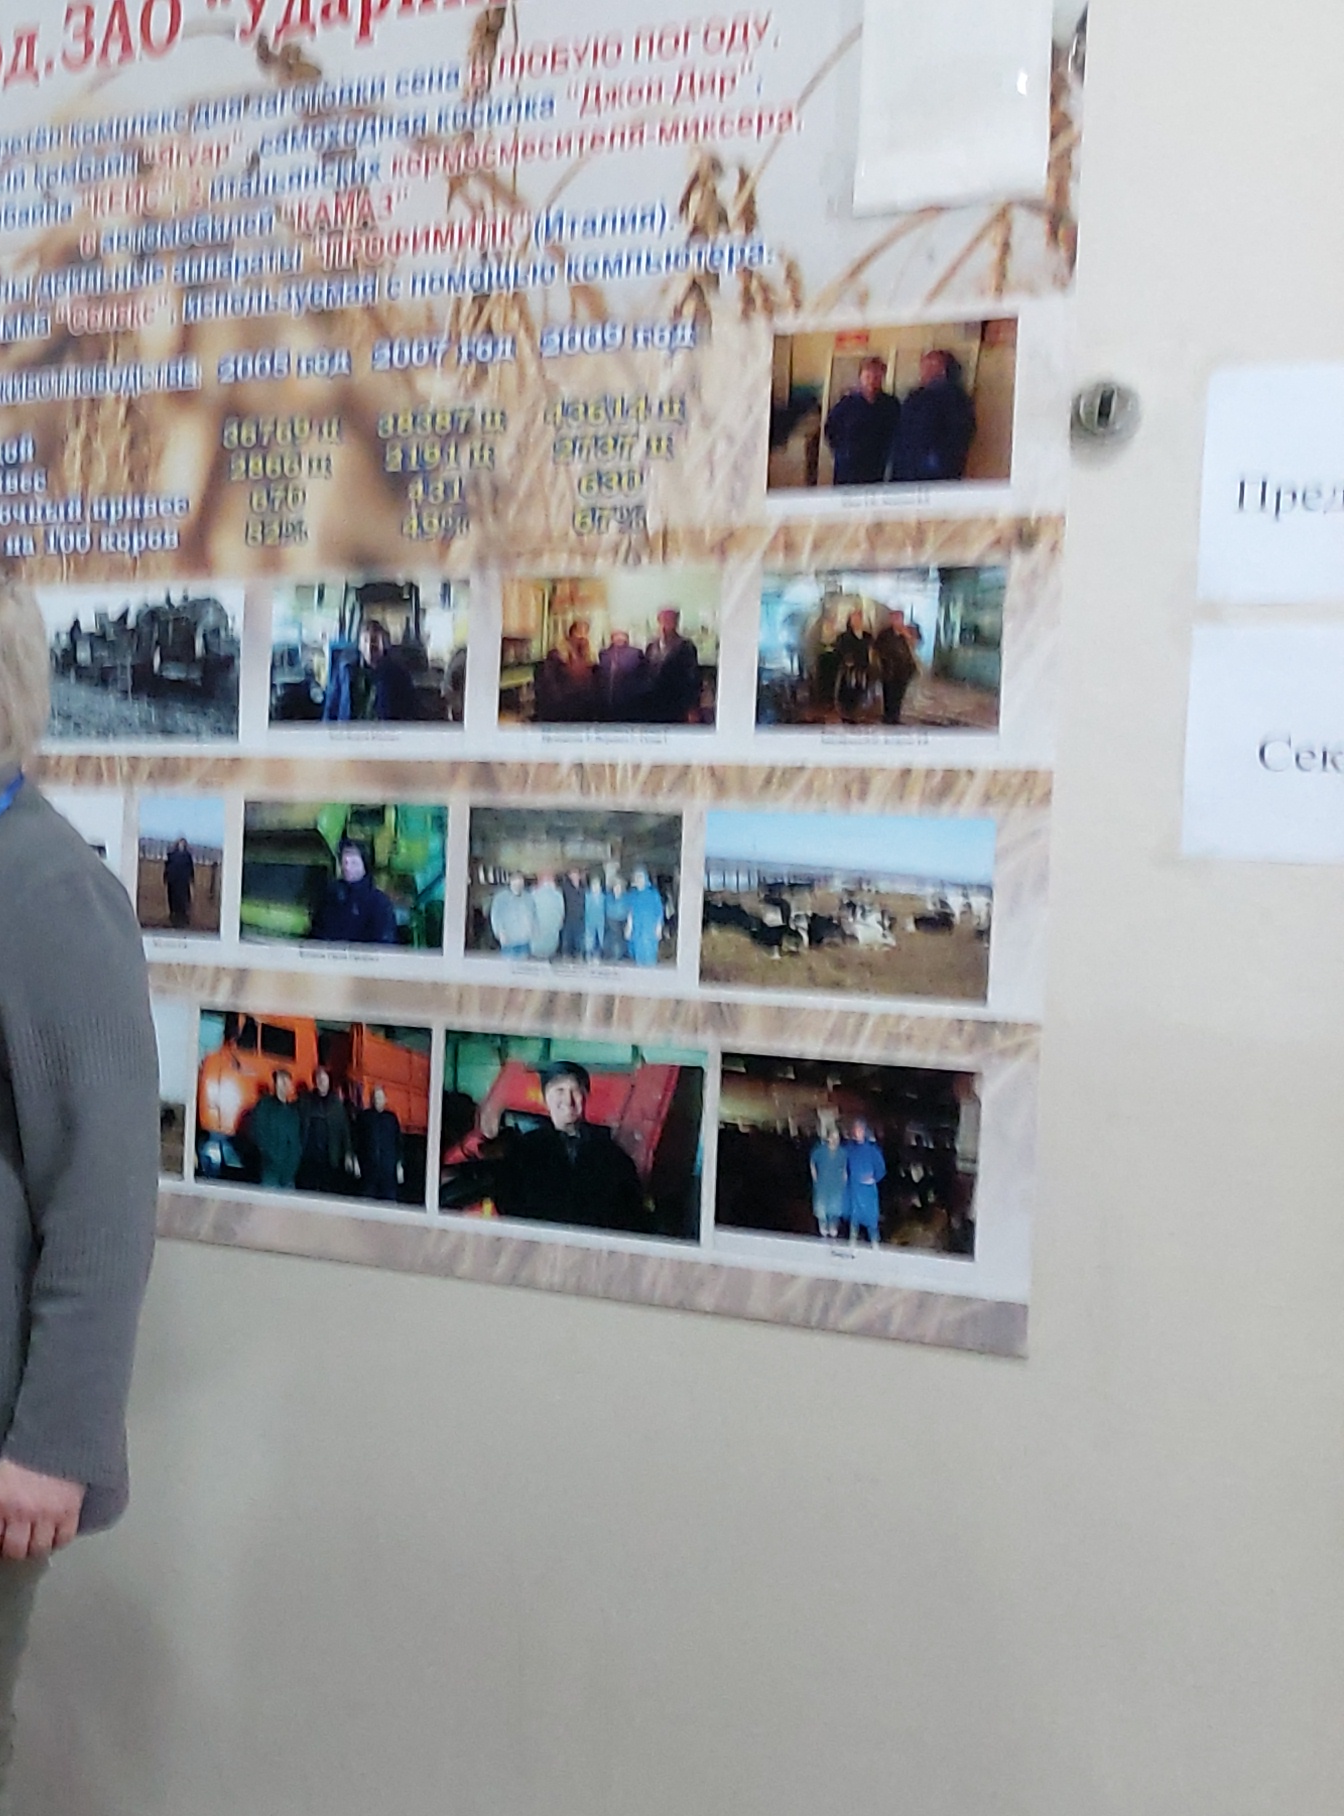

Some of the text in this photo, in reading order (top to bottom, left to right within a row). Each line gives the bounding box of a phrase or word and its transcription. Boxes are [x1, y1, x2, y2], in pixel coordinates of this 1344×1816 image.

[395, 65, 460, 98] сена
[298, 349, 352, 380] год
[459, 334, 517, 367] год
[632, 322, 698, 353] год
[45, 526, 92, 558] 100
